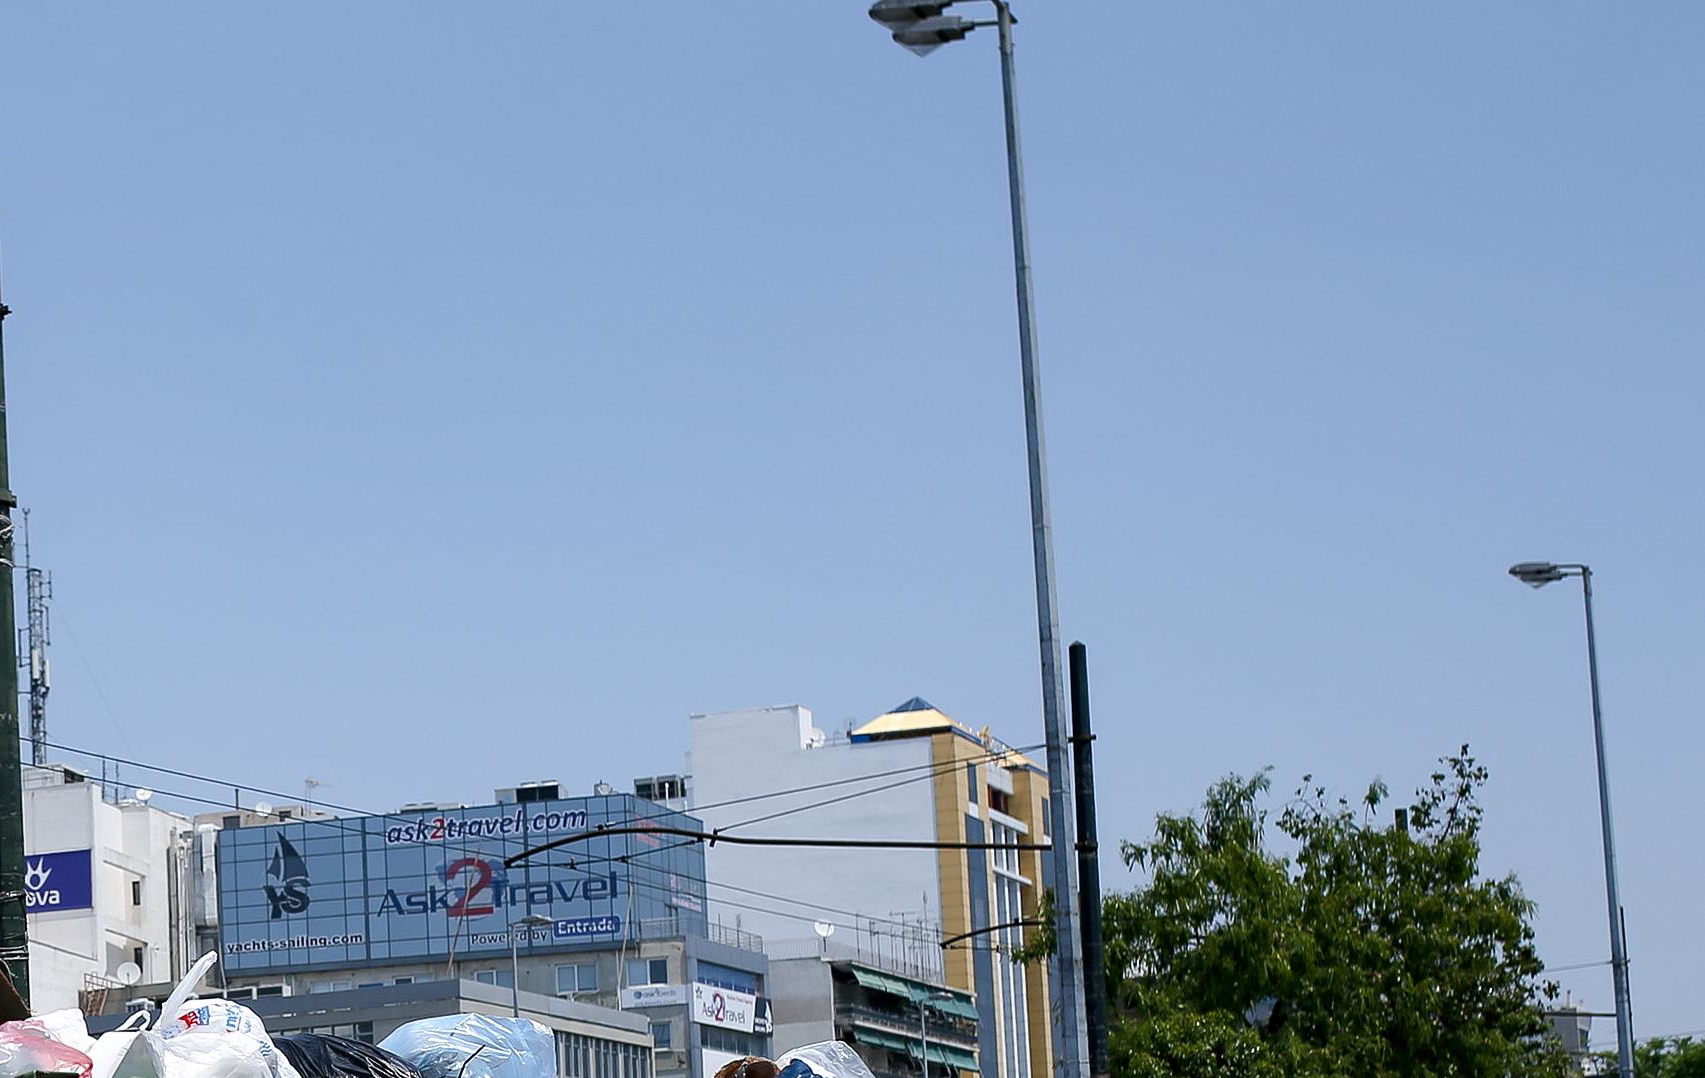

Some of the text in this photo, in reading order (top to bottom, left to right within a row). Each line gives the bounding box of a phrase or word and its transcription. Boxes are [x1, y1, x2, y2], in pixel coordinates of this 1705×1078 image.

[386, 808, 587, 844] ask2travel.com
[26, 889, 60, 907] ova
[471, 918, 616, 946] Poweed by Entrada
